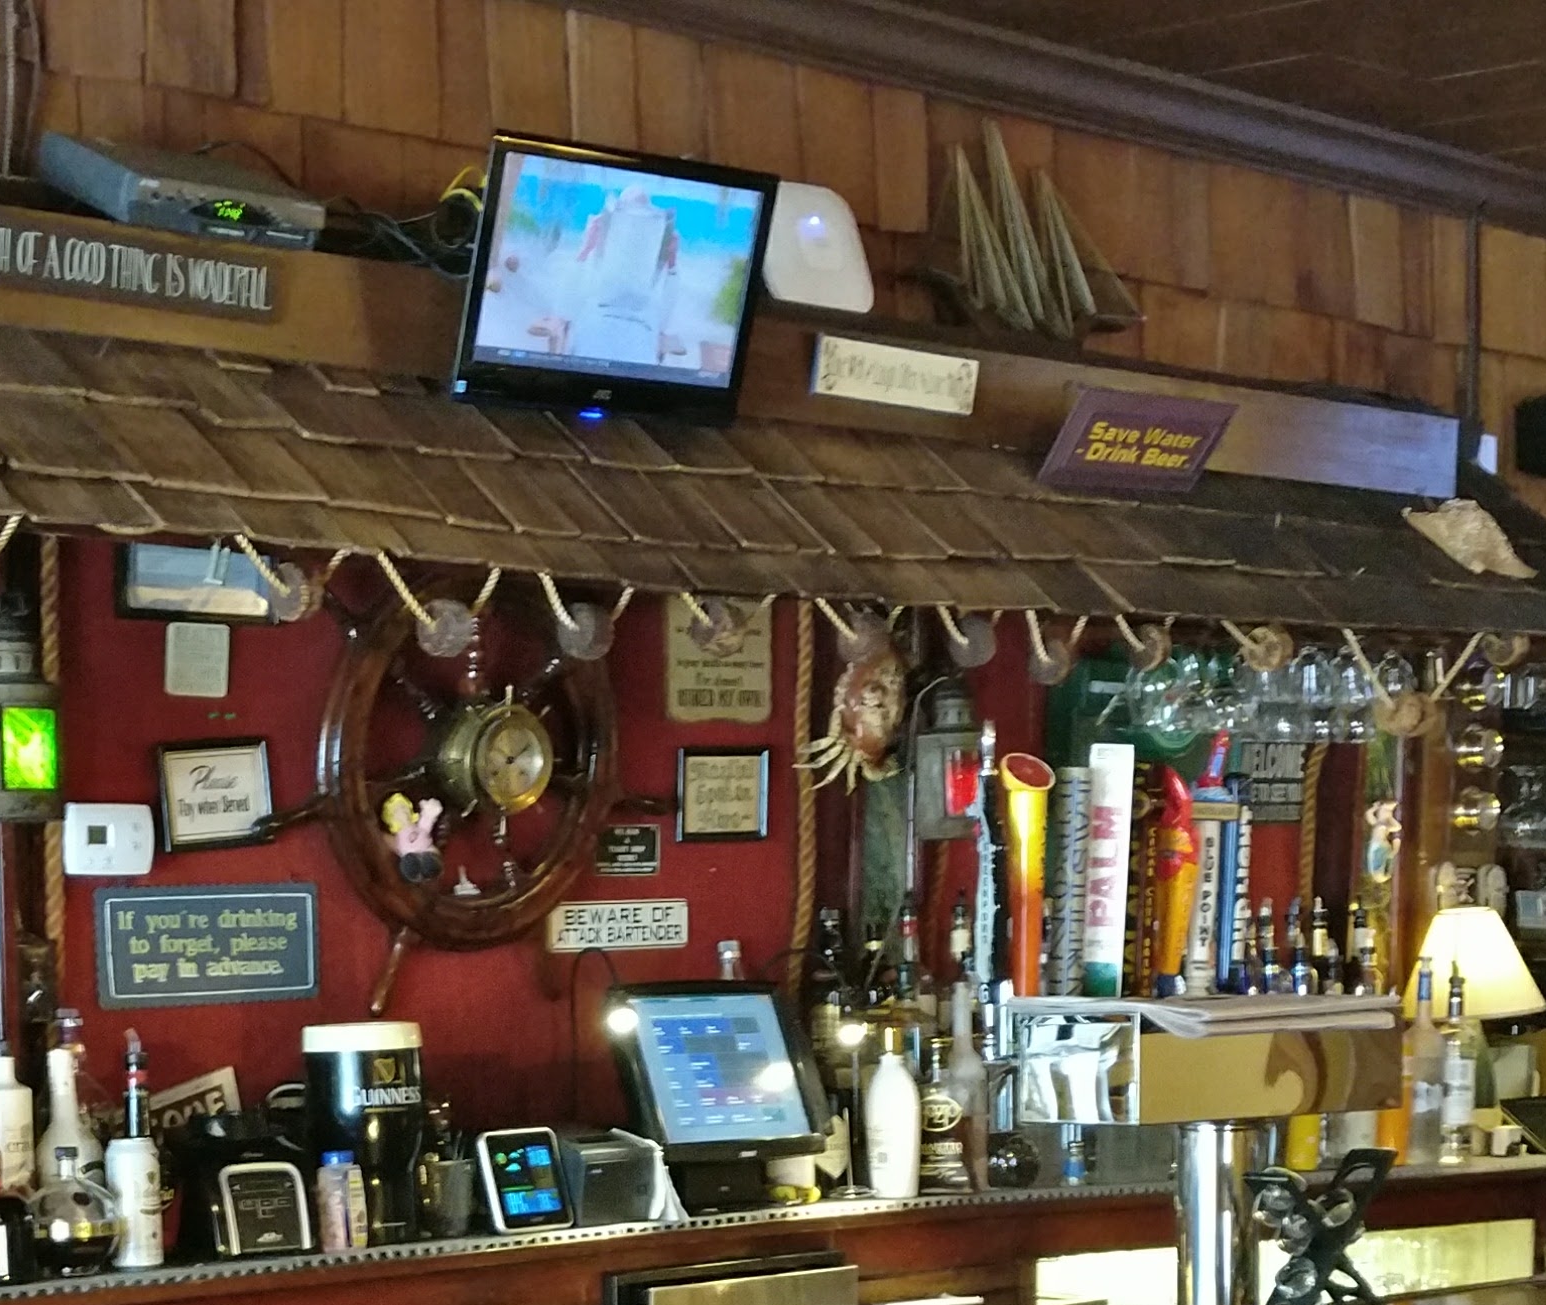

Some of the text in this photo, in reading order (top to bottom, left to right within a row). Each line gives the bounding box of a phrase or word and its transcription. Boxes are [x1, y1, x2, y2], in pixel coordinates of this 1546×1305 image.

[16, 231, 43, 275] OF
[42, 235, 61, 279] A
[63, 238, 106, 285] GOOD
[108, 243, 163, 294] THING
[165, 252, 185, 297] IS
[188, 257, 273, 310] WONDERFUL
[1088, 421, 1203, 450] Save Water
[1085, 442, 1138, 465] Drink
[1086, 806, 1121, 927] PALM
[1199, 837, 1215, 947] BLUE POINT
[116, 908, 298, 934] If you're drinking
[564, 906, 675, 926] BEWARE OF
[129, 933, 288, 957] to forget, please
[556, 924, 683, 943] ATTACK BARTENDER
[132, 962, 170, 984] pay
[176, 957, 200, 978] in
[350, 1086, 421, 1105] GUINNESS
